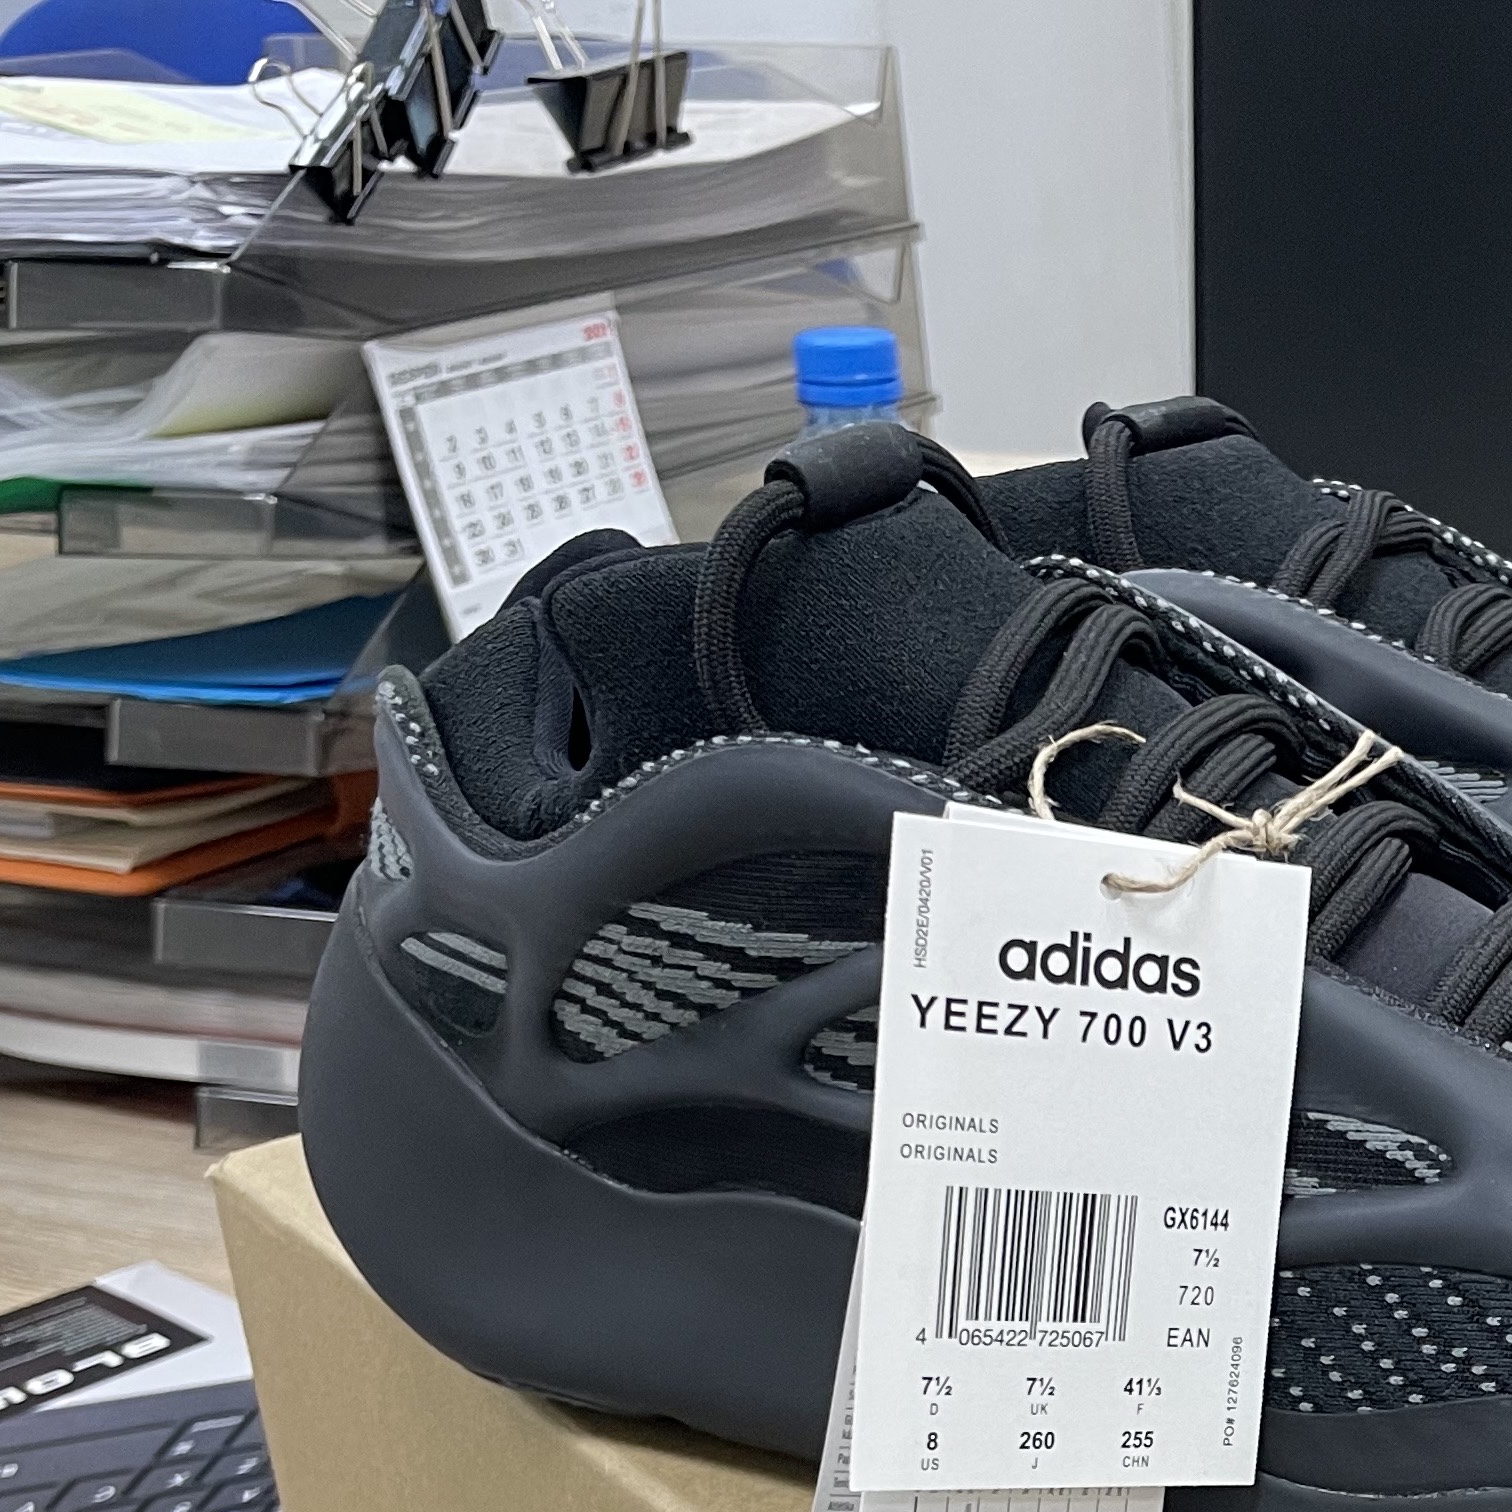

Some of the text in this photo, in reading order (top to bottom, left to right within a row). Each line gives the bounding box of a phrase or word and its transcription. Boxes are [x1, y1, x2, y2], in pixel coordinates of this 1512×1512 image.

[914, 849, 934, 969] HSD2E/0420/V01
[999, 931, 1200, 997] adidas
[911, 994, 1213, 1053] YEEZY 700 V3
[902, 1112, 999, 1134] ORIGINALS
[900, 1143, 998, 1164] ORIGINALS
[1163, 1206, 1230, 1231] GX6144
[1178, 1285, 1215, 1306] 720
[915, 1327, 1105, 1349] 4 065422 725067
[1166, 1327, 1211, 1349] EAN
[929, 1403, 939, 1416] D
[1030, 1402, 1049, 1416] UK
[1136, 1403, 1144, 1415] F
[926, 1432, 938, 1452] 8
[1019, 1431, 1055, 1450] 260
[1121, 1430, 1154, 1449] 255
[1223, 1416, 1236, 1447] PO#
[920, 1457, 940, 1472] US
[1031, 1456, 1038, 1470] J
[1122, 1454, 1150, 1469] CHN
